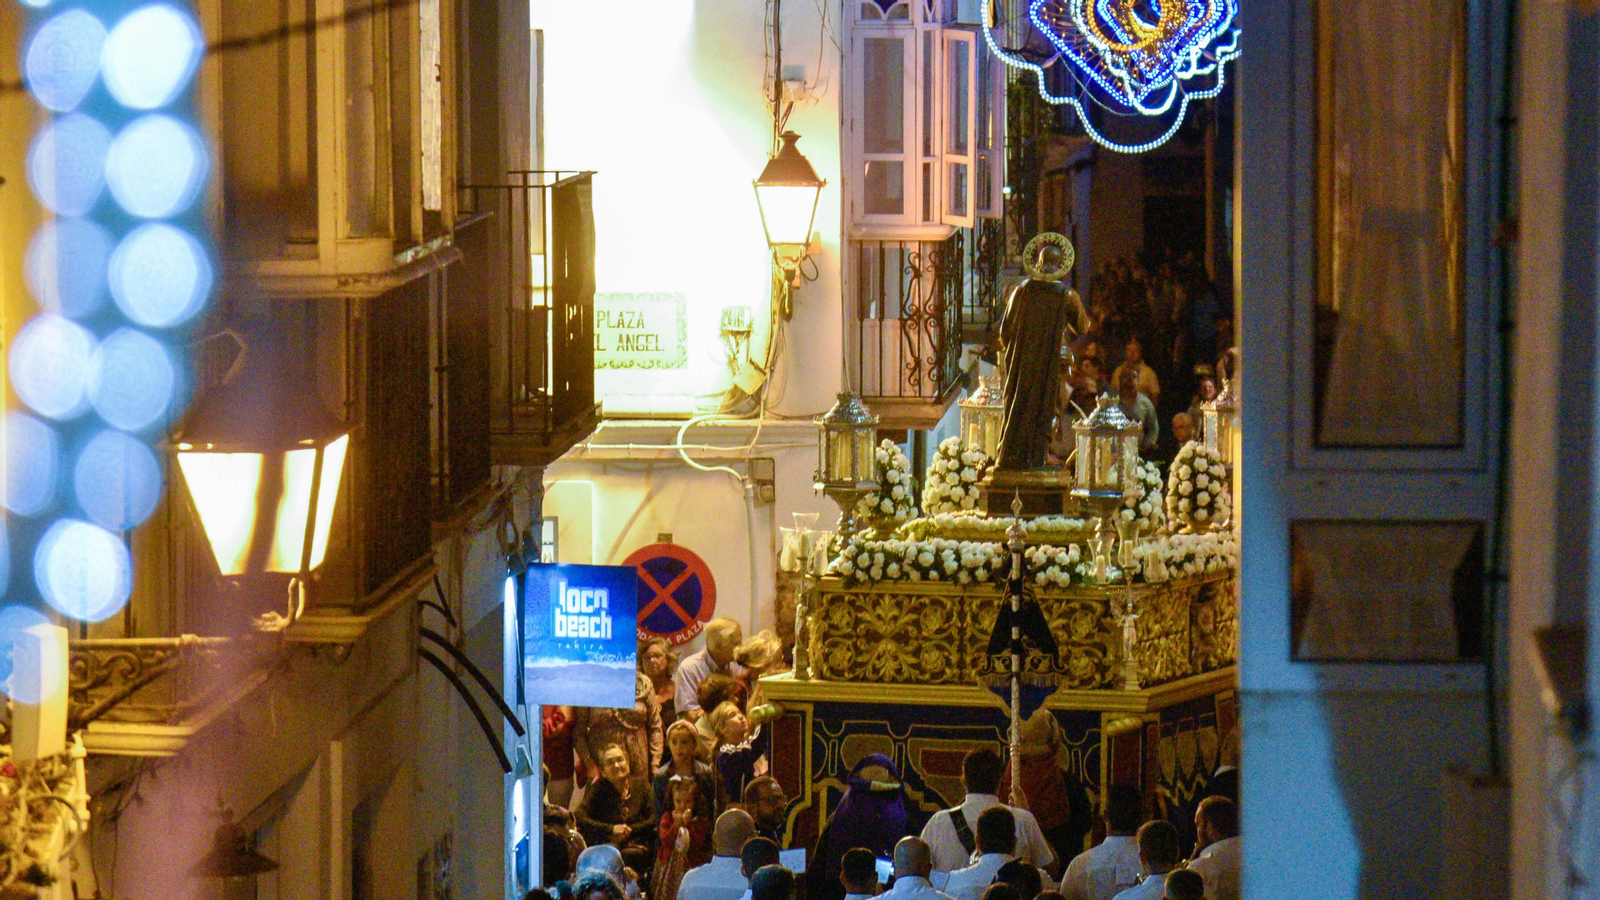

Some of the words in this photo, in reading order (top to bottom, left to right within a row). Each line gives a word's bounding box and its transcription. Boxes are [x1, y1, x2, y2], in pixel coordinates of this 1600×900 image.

[597, 310, 645, 329] PLAZA
[594, 333, 607, 352] L
[555, 607, 613, 640] beach
[675, 620, 704, 644] PLAZA
